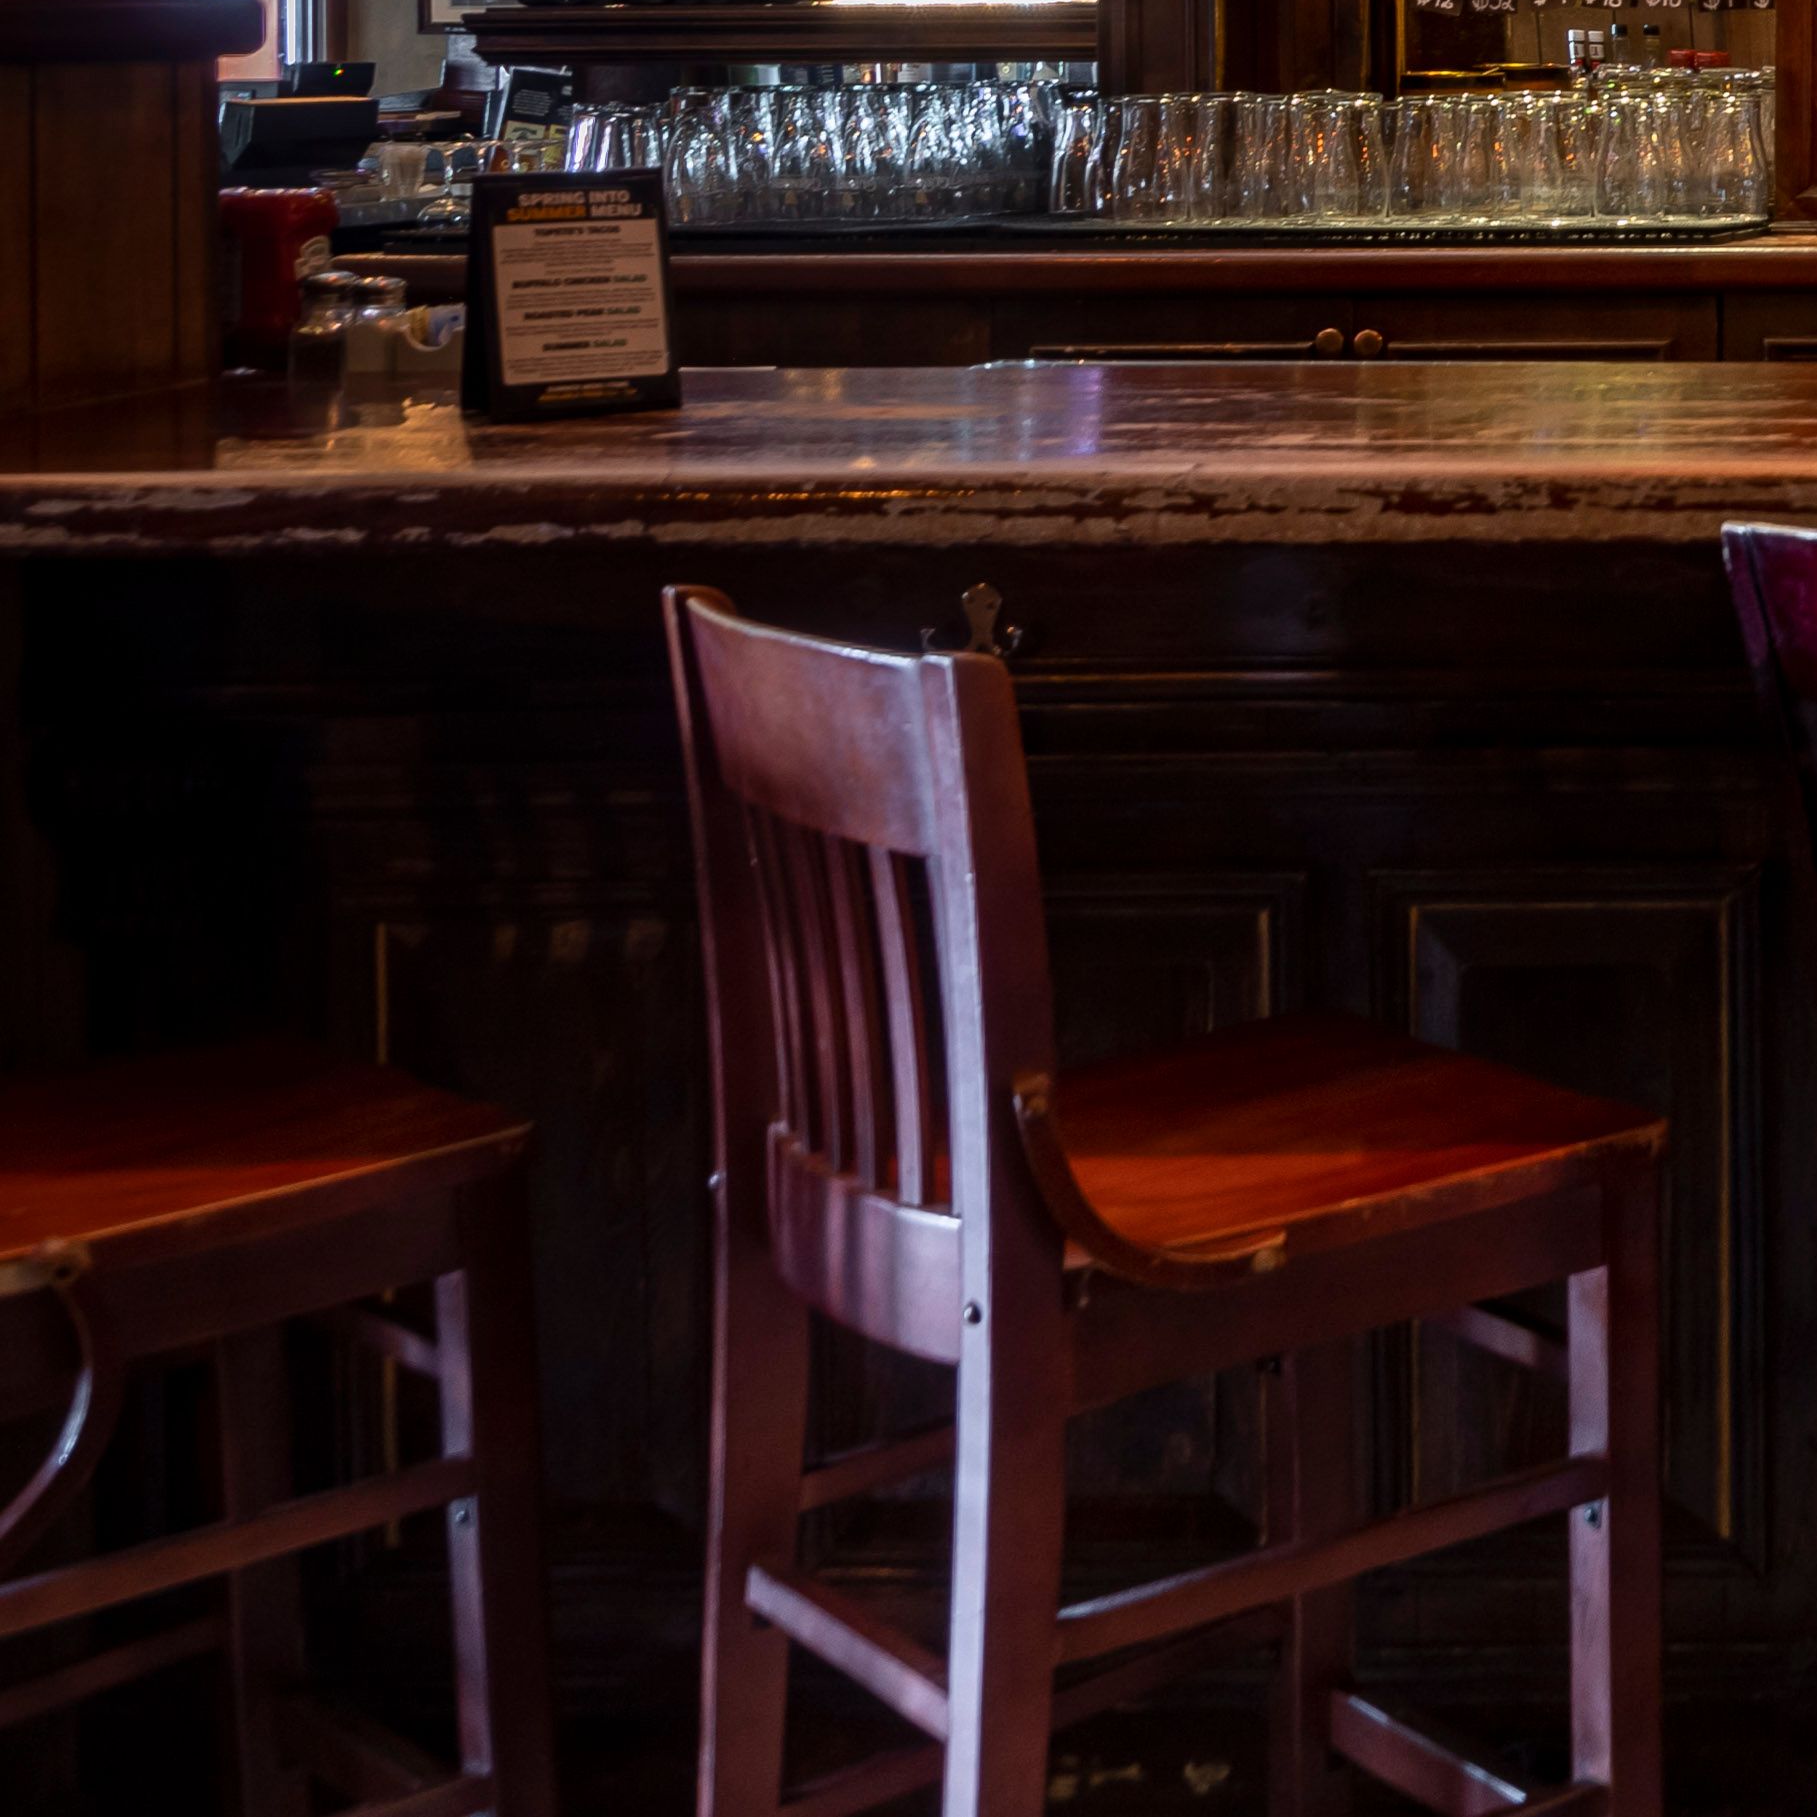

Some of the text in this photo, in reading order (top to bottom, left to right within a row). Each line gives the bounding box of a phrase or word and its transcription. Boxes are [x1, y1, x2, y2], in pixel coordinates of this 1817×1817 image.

[518, 190, 630, 206] SPRING INTO
[507, 204, 643, 221] SUMMER MENU
